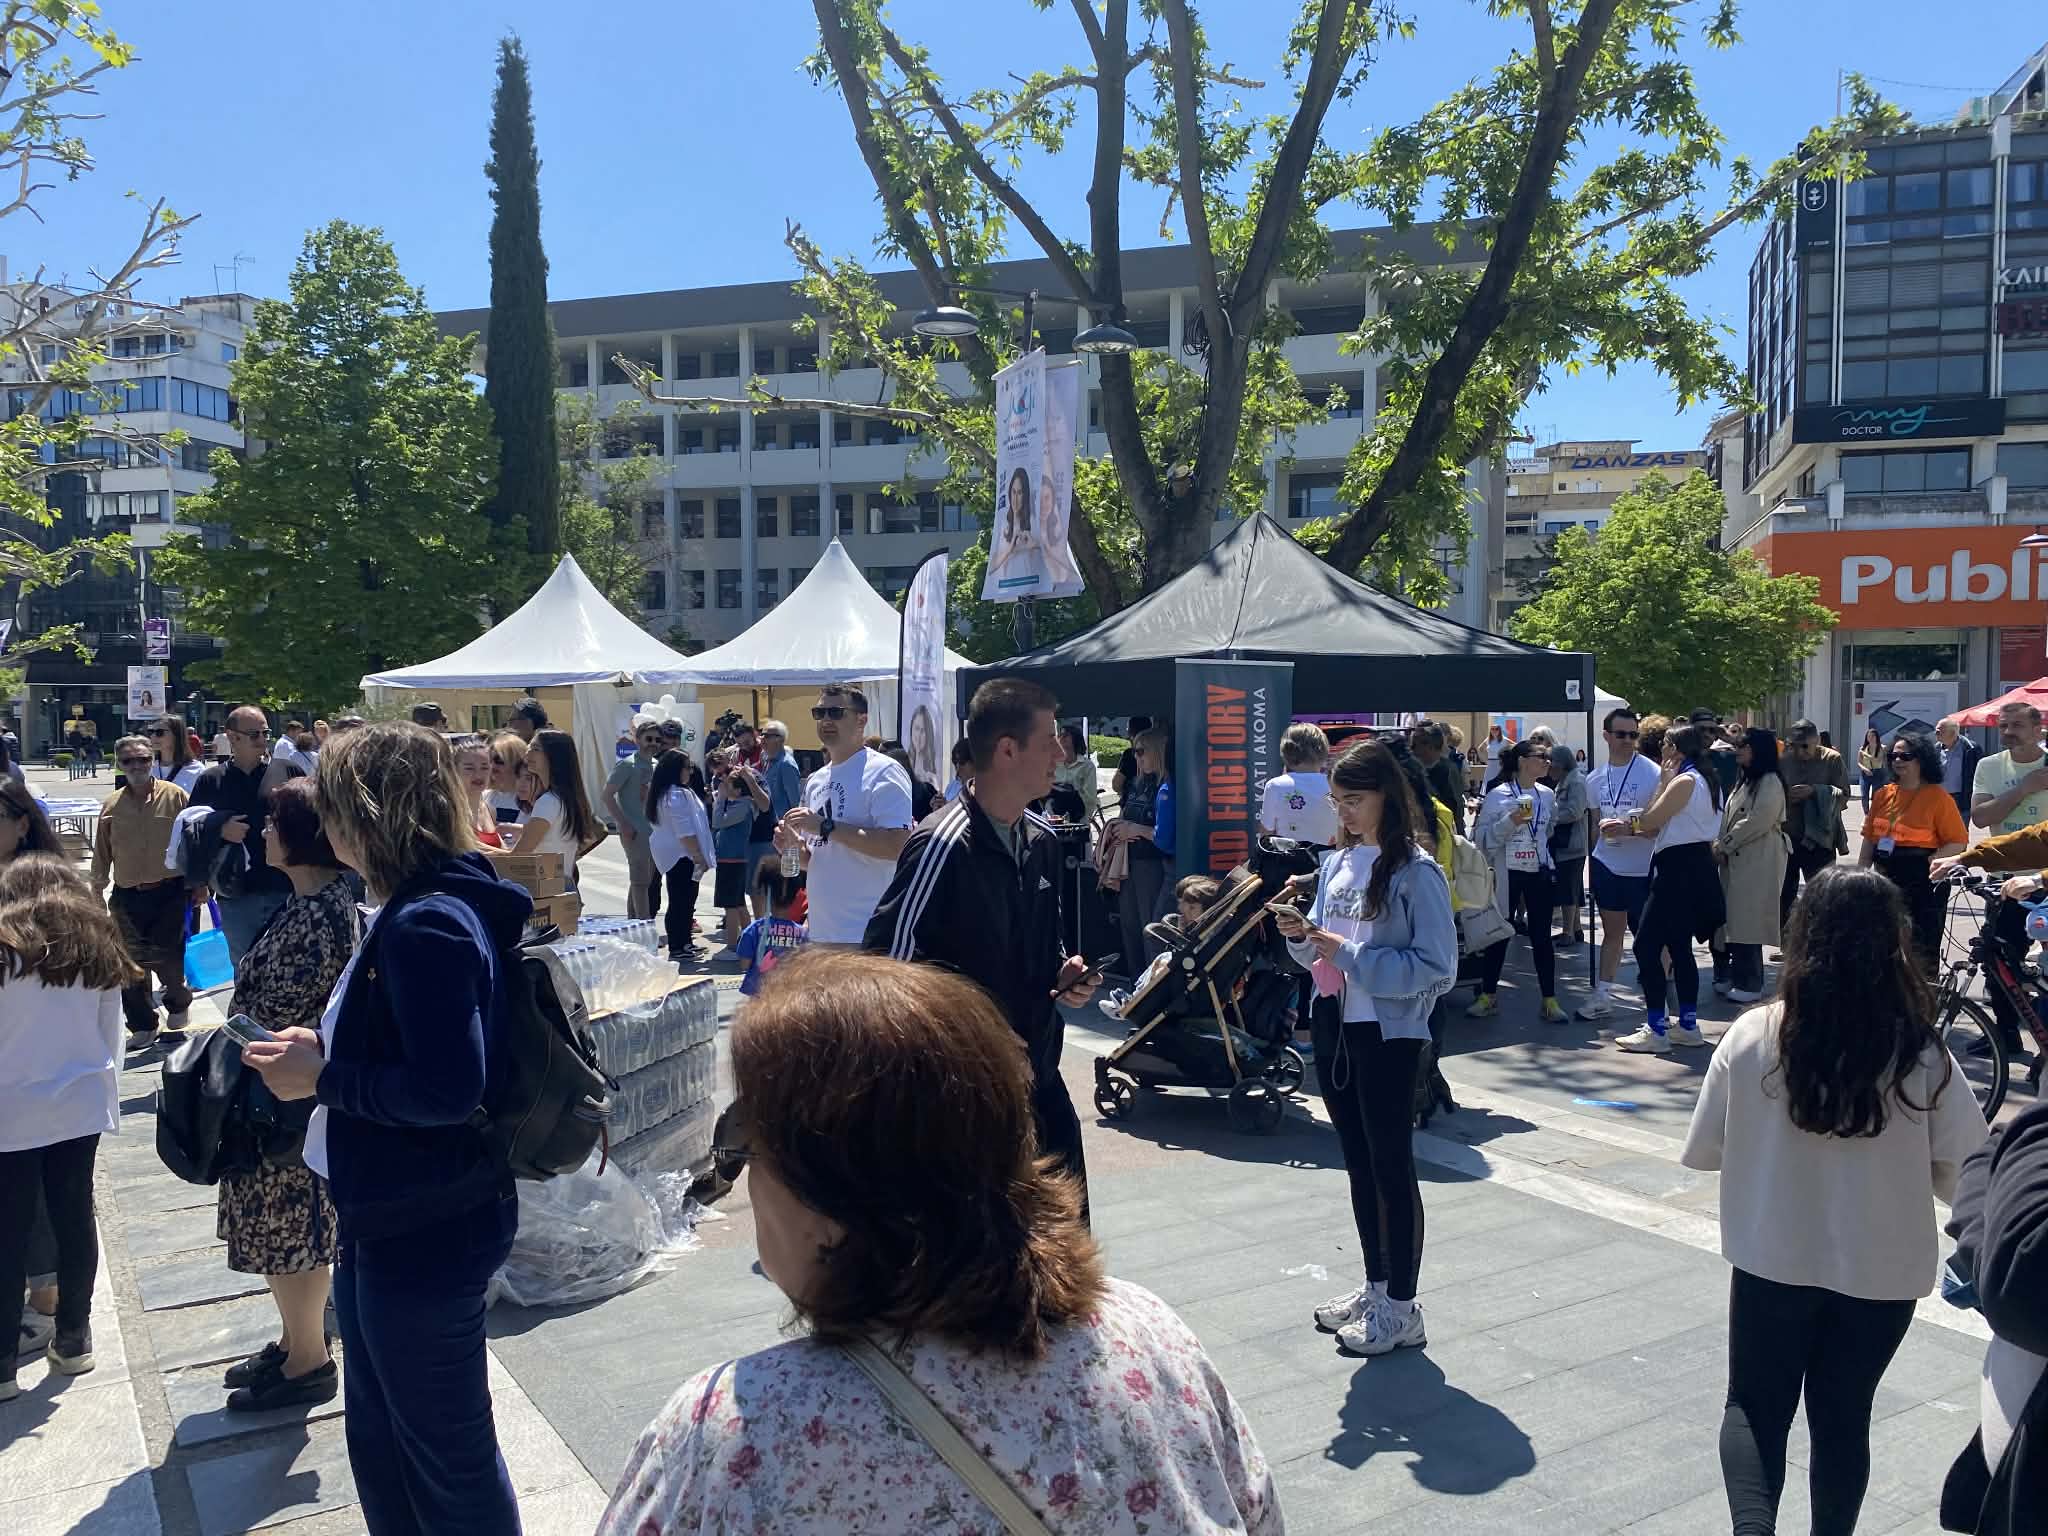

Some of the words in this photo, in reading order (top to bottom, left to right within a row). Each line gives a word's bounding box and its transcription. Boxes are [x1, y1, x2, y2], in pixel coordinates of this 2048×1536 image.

[1841, 426, 1883, 436] DOCTOR
[1571, 452, 1689, 470] DANZAS
[1207, 684, 1249, 821] FACTORY
[1514, 850, 1536, 859] 0217
